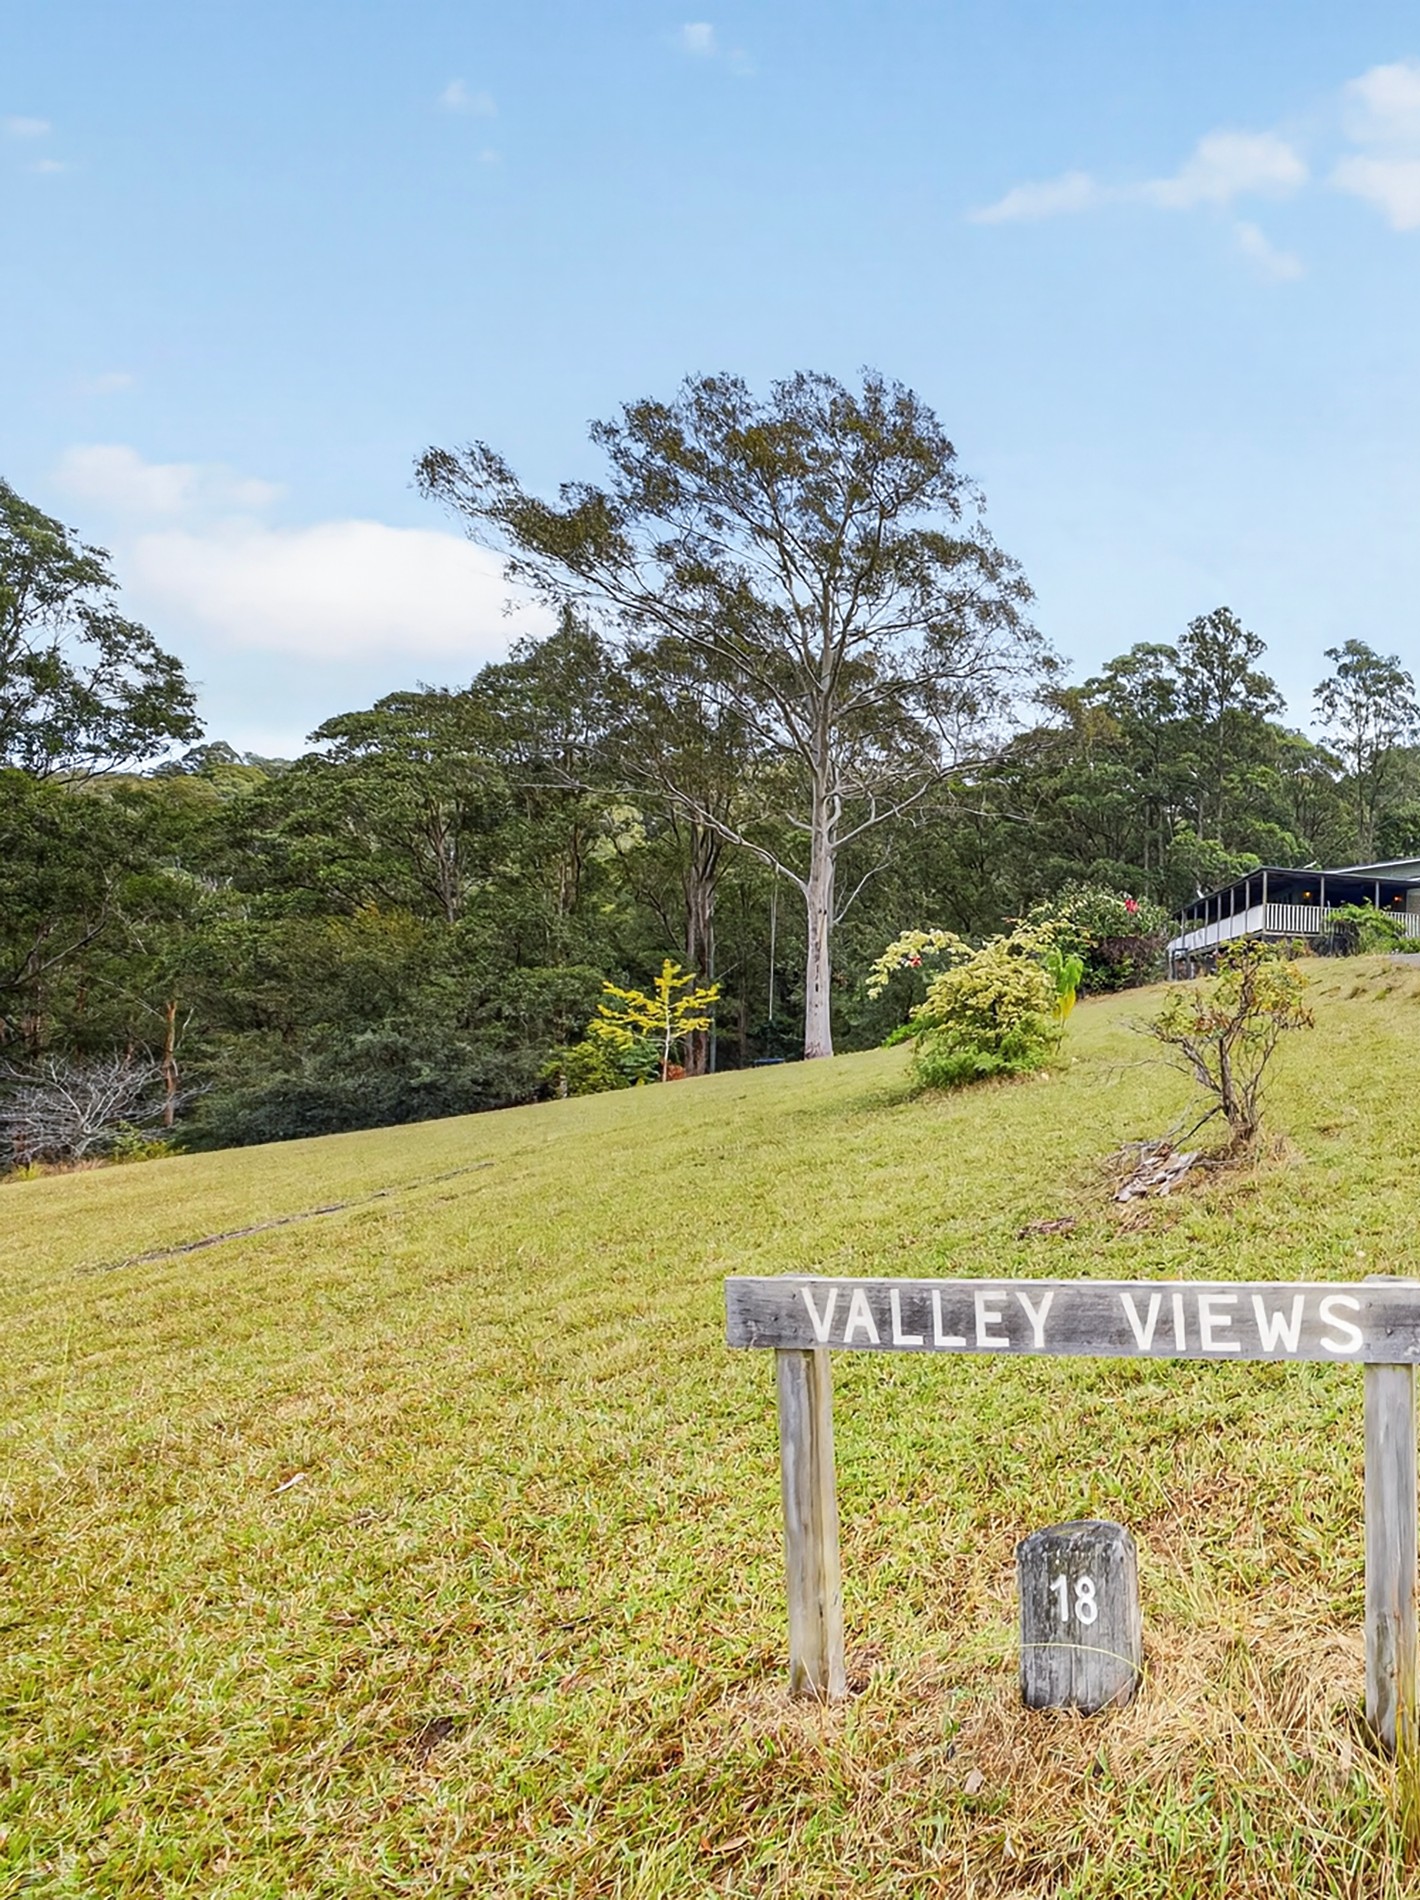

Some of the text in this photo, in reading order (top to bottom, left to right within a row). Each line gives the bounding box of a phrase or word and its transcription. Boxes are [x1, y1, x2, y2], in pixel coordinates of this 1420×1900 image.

[800, 1286, 1365, 1355] VALLEY VIEWS
[1049, 1573, 1098, 1626] 18
